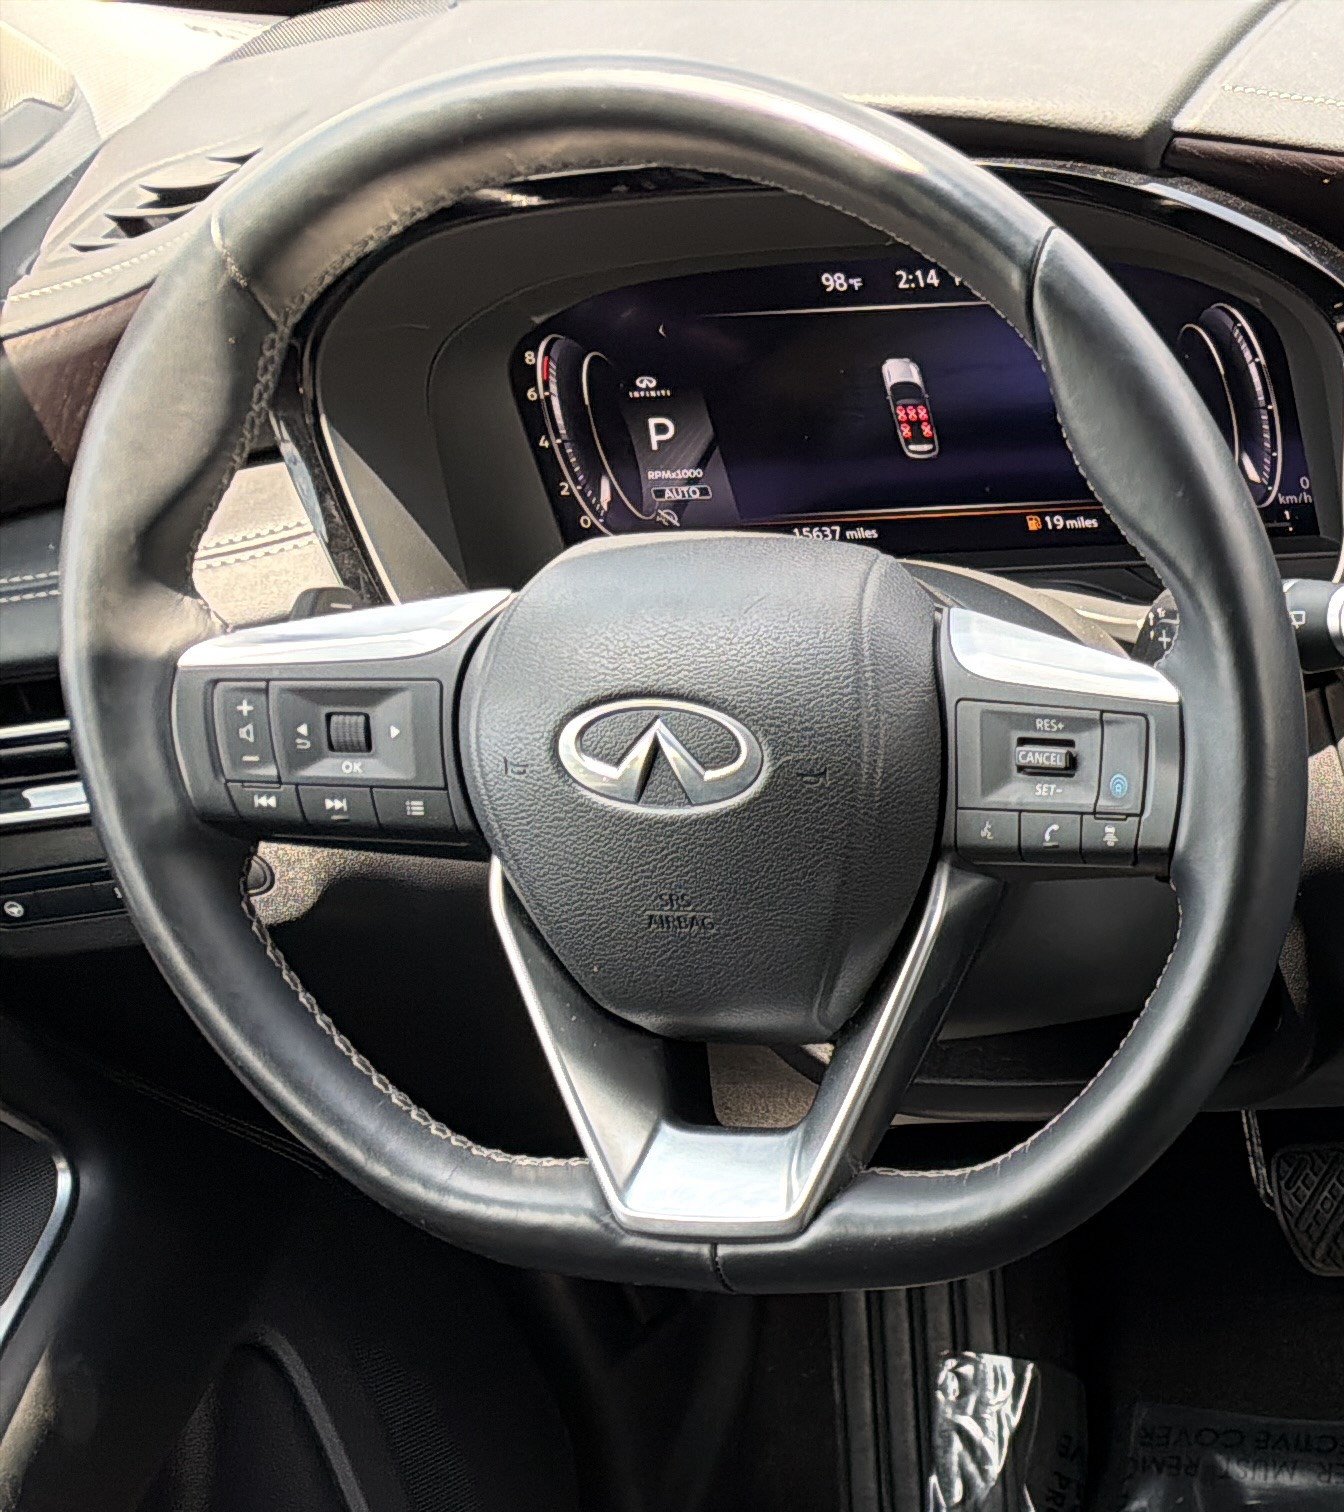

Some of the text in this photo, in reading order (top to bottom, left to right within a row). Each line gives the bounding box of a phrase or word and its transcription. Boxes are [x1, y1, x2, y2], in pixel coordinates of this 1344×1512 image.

[895, 268, 941, 290] 2:14
[524, 350, 536, 366] 8
[526, 386, 538, 401] 6
[538, 434, 549, 449] 4
[647, 417, 675, 451] P
[559, 482, 570, 496] 2
[664, 485, 701, 499] AUTO
[1277, 491, 1313, 505] km/h
[579, 515, 592, 530] 0
[1044, 515, 1099, 530] 19 miles
[845, 528, 879, 540] miles
[1035, 718, 1066, 733] RES+
[1018, 750, 1064, 768] CANCEL
[341, 760, 364, 774] OK
[1034, 783, 1064, 797] SET-
[1139, 1424, 1247, 1449] COVER
